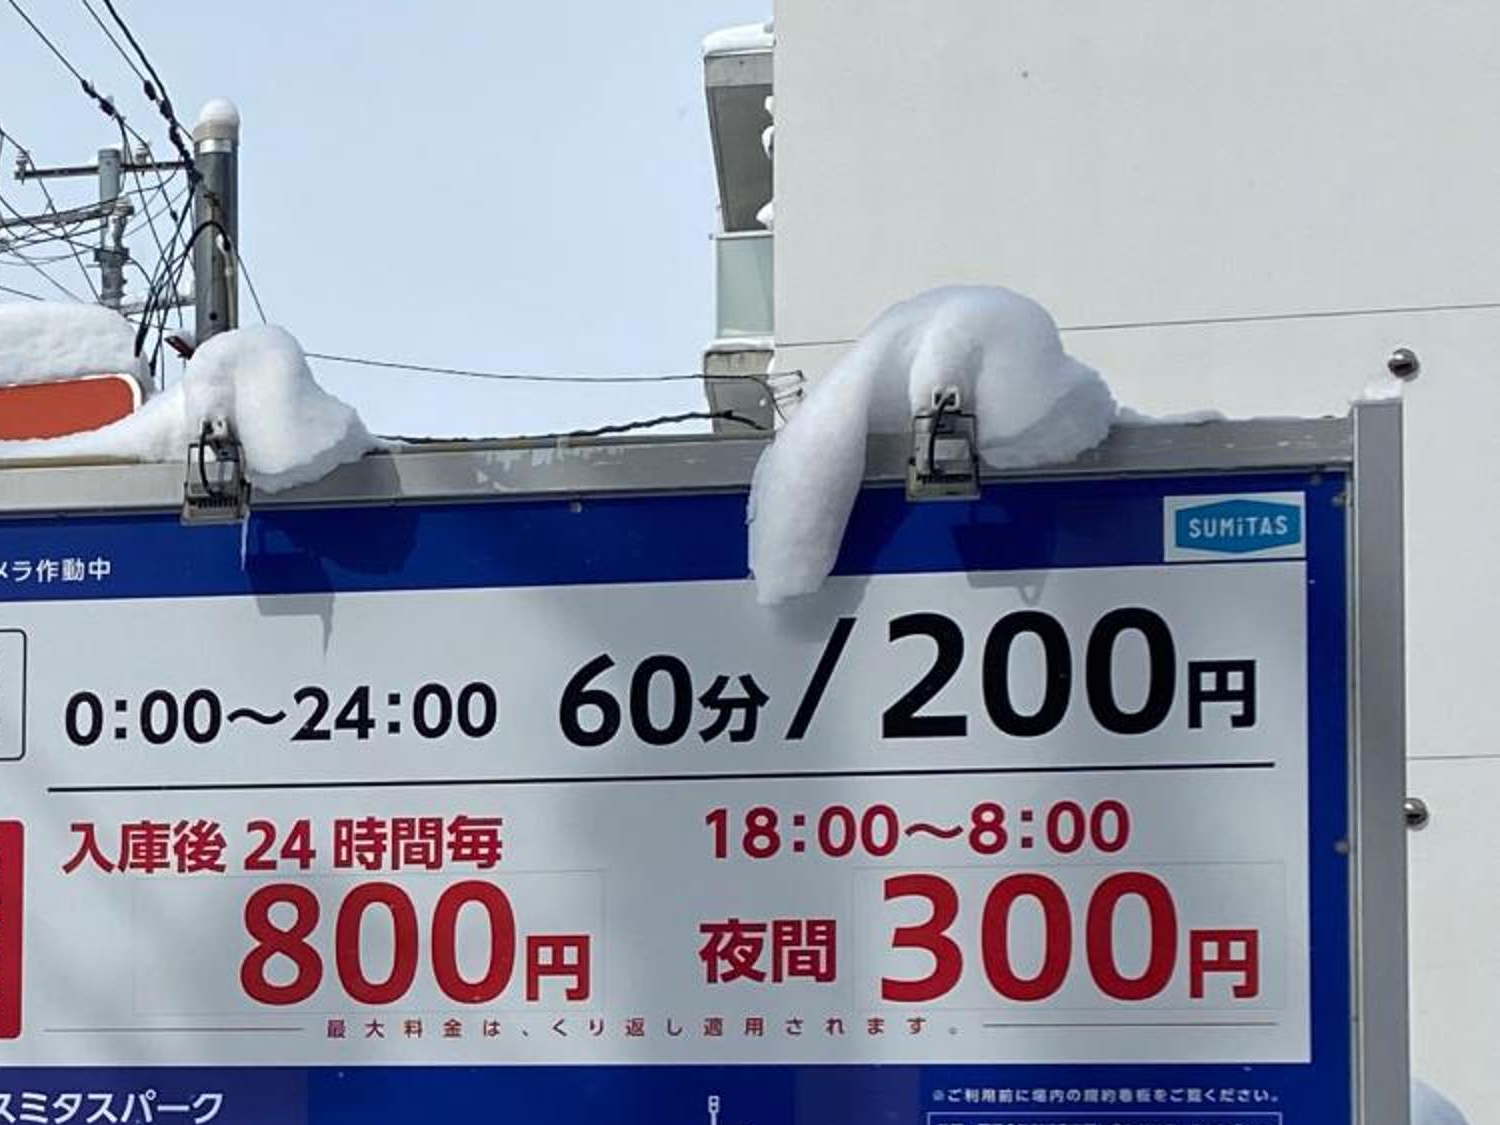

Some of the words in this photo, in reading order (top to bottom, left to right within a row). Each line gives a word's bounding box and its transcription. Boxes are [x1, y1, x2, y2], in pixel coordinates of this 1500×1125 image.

[239, 879, 592, 1007] 800円
[699, 917, 838, 986] 夜間
[880, 871, 1260, 1004] 300円
